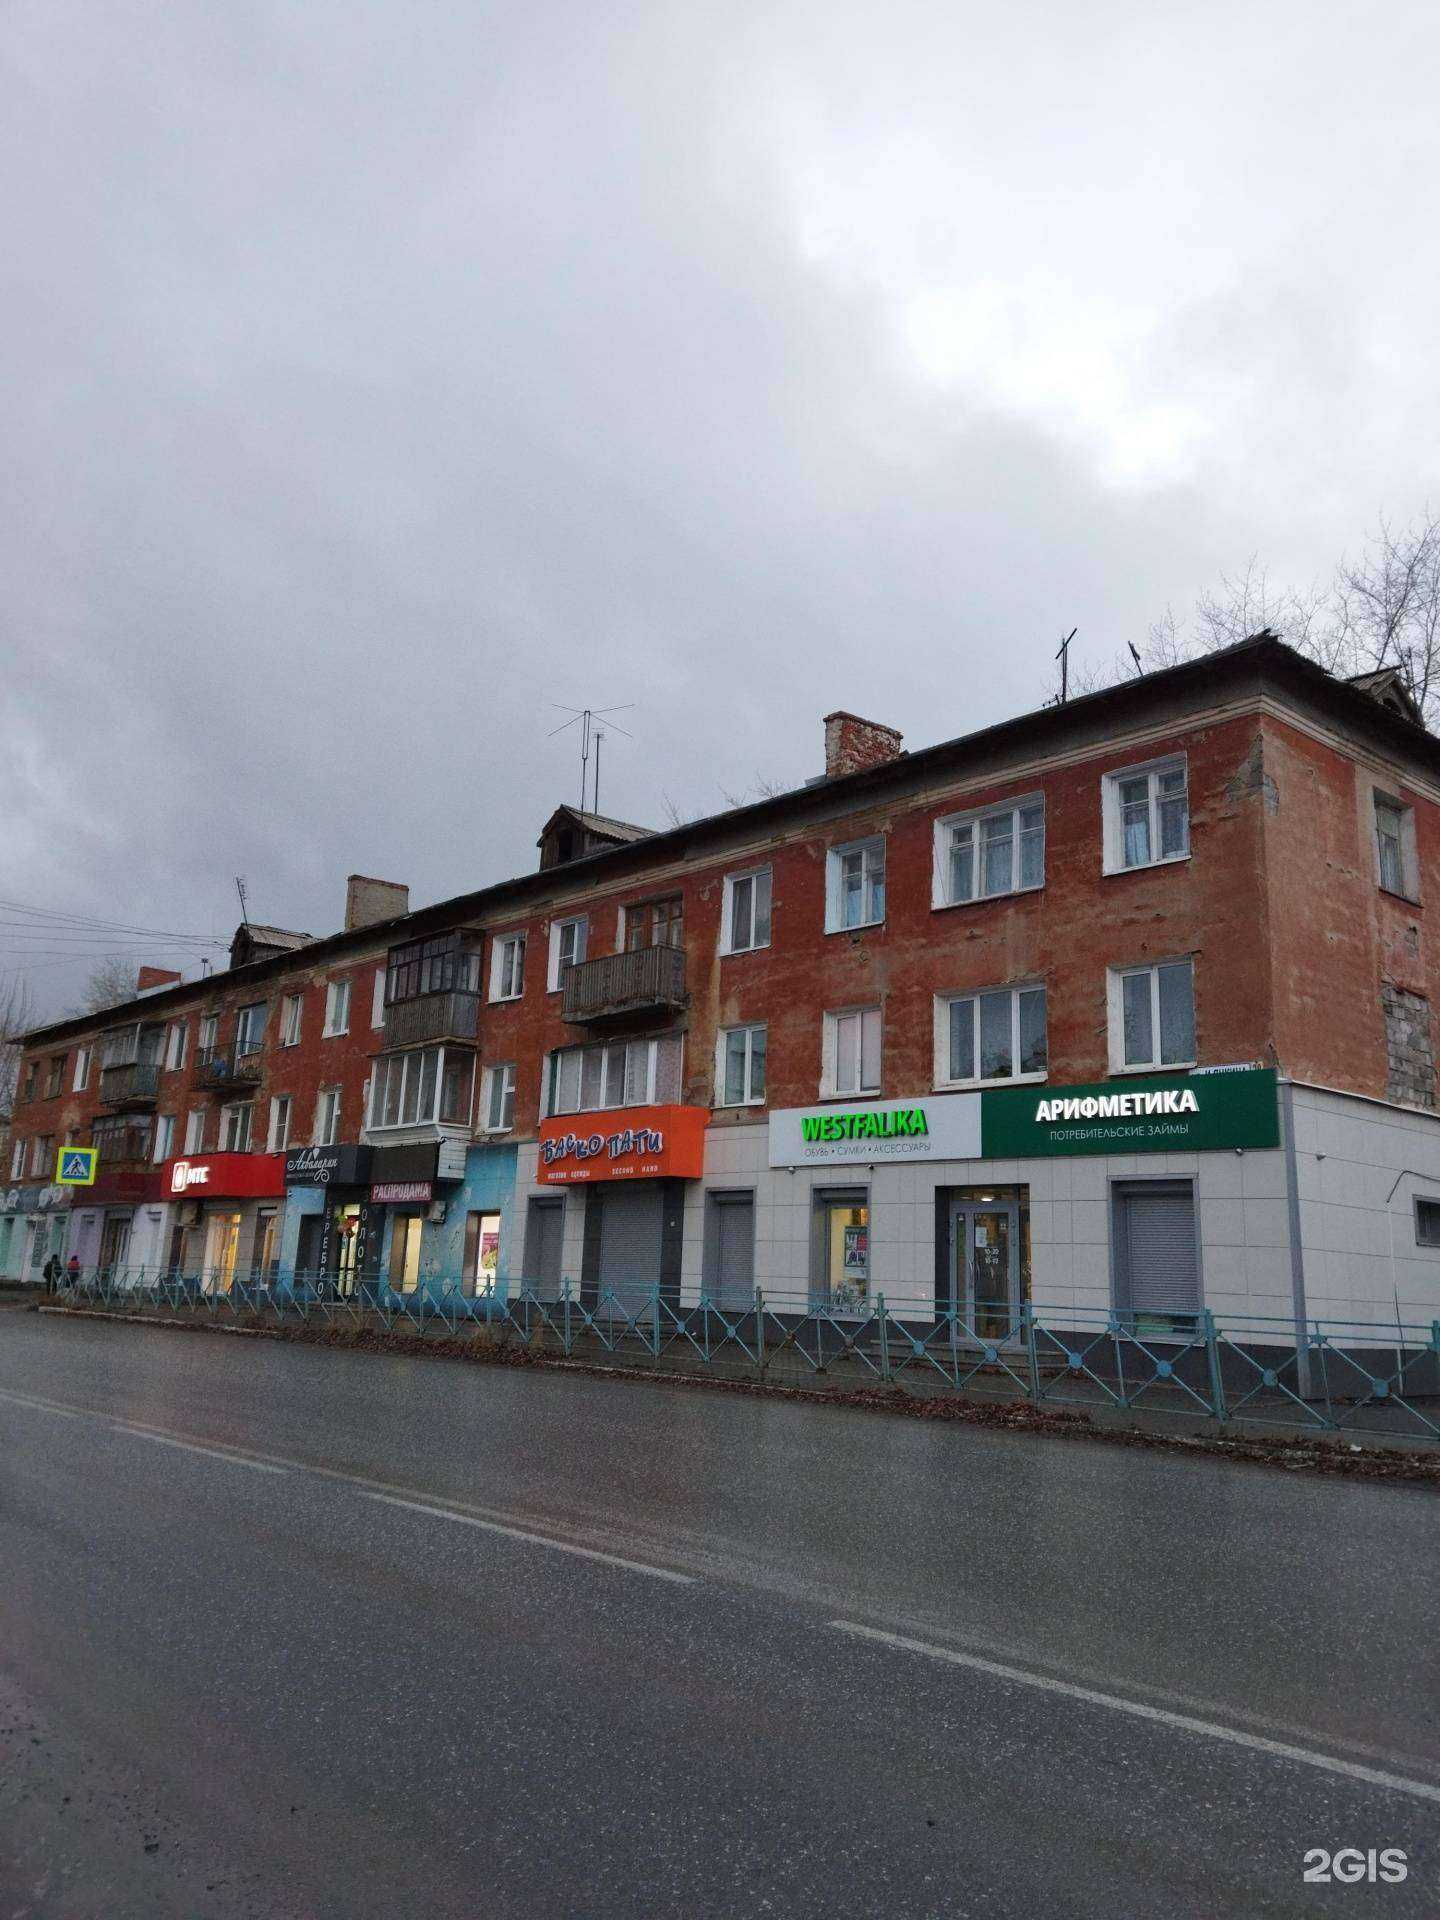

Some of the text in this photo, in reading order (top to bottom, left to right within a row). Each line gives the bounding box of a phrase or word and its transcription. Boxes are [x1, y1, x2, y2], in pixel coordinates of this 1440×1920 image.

[1035, 1089, 1200, 1122] АРИФМЕТИКА
[800, 1108, 929, 1141] WESTFALIKA
[1050, 1122, 1189, 1141] ПОТРЕБИТЕЛЬСКИЕ ЗАЙМЫ
[837, 1145, 866, 1156] СУМКИ
[873, 1142, 931, 1154] АКСЕССУАРЫ
[317, 1193, 331, 1295] ЕРЕБРО
